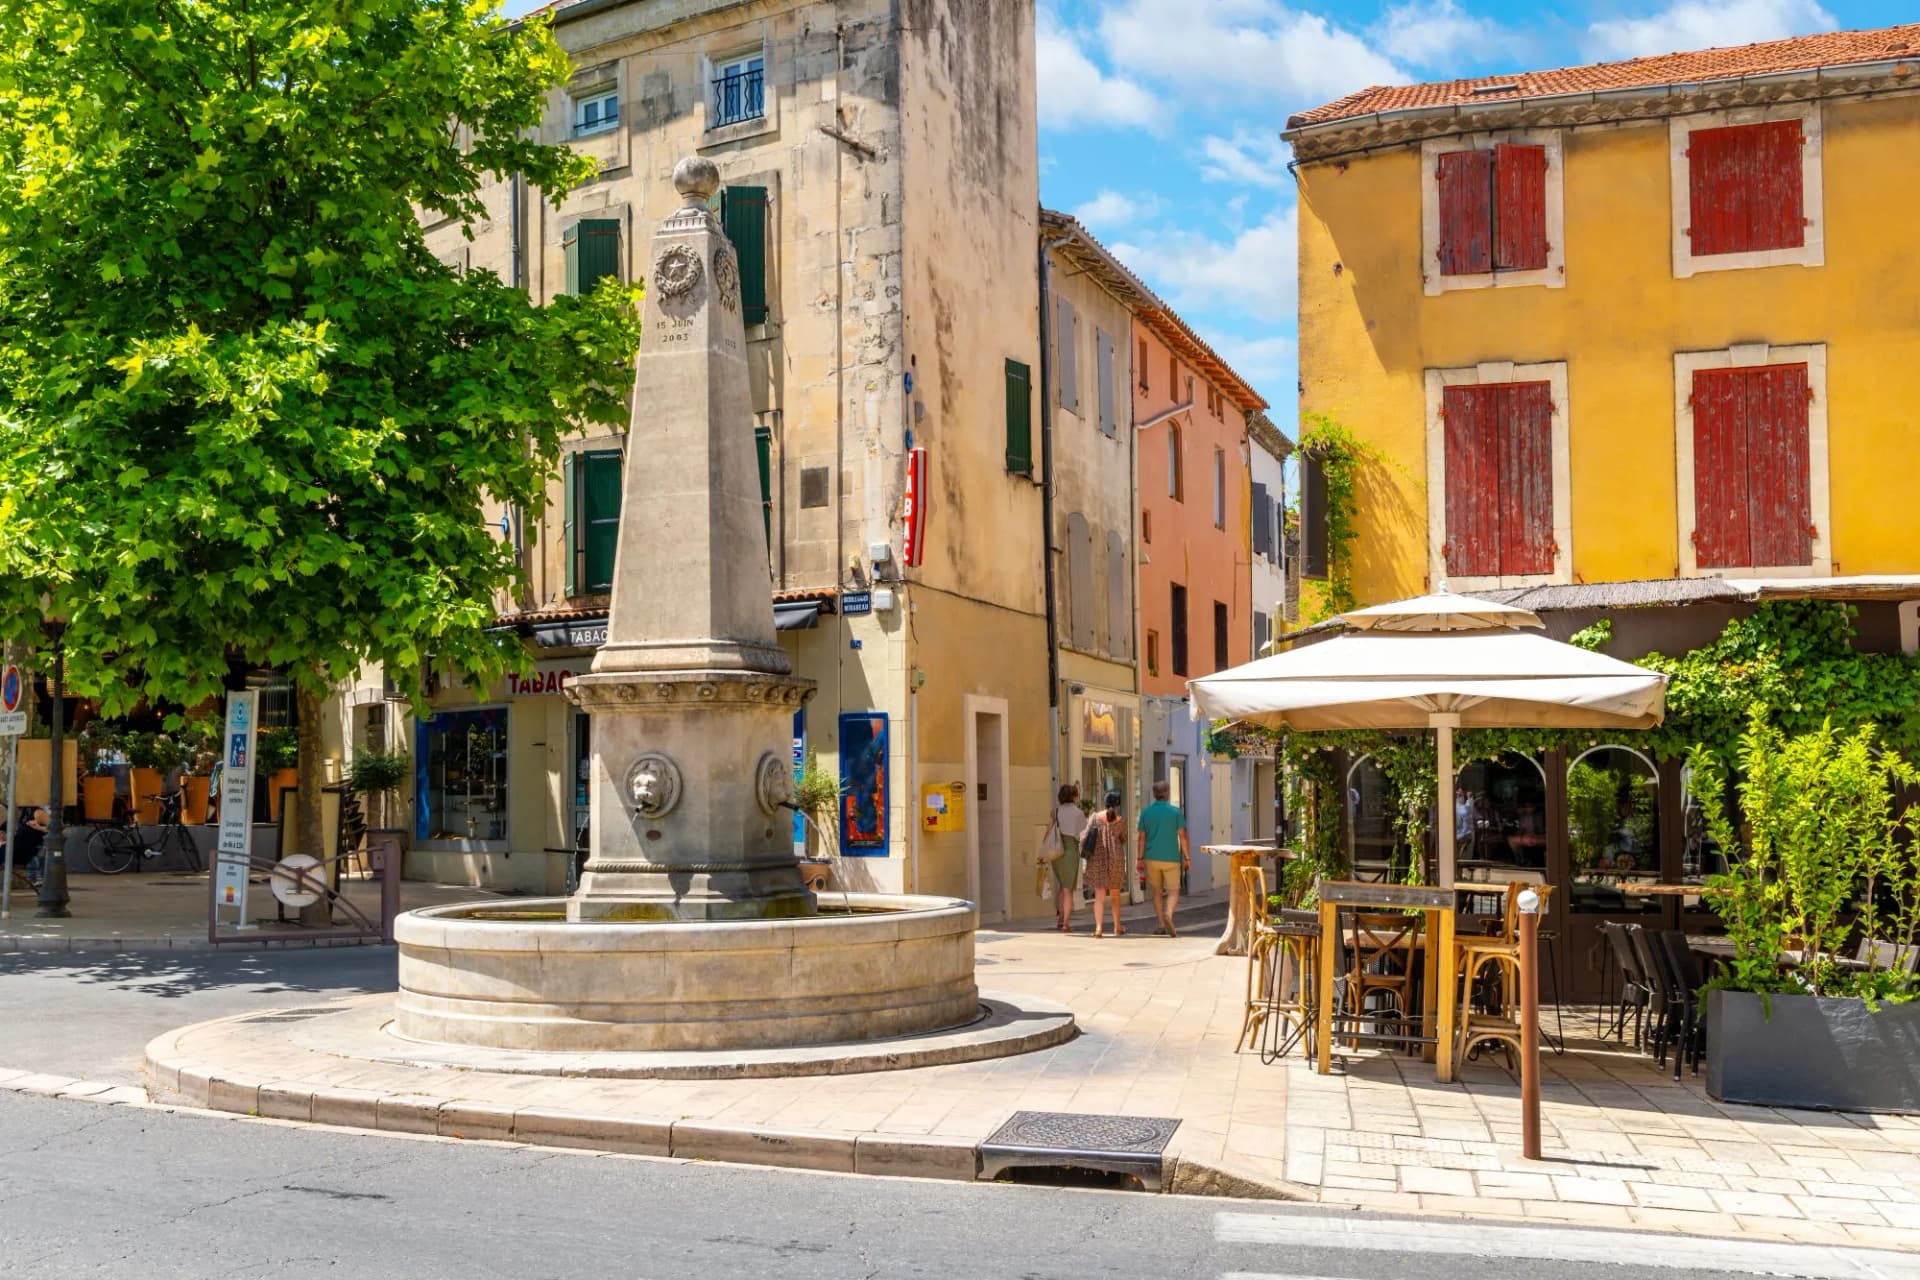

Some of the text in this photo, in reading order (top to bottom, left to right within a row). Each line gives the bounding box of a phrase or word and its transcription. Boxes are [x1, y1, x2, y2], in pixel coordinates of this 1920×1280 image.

[656, 319, 694, 329] 15 JUIN
[903, 452, 914, 560] TABAC
[844, 603, 869, 612] MIRABEAU
[569, 630, 609, 644] TABAC
